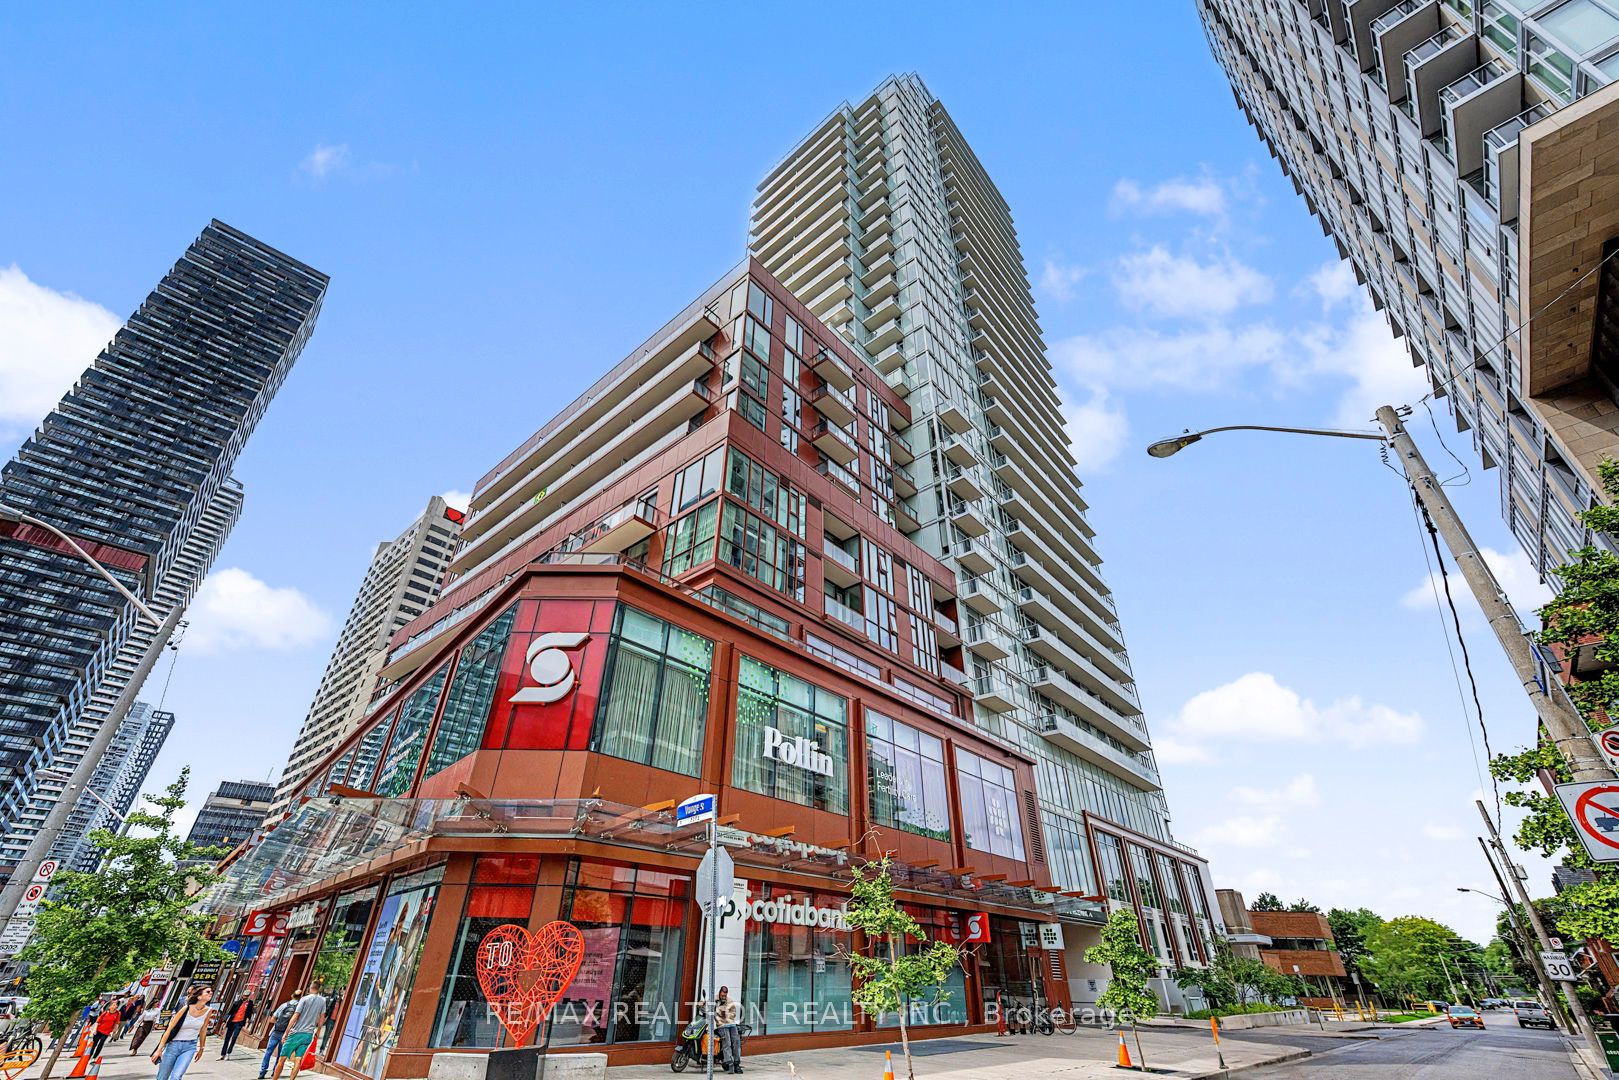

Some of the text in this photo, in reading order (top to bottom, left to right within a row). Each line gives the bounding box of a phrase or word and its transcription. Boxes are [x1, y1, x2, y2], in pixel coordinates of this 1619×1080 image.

[763, 725, 834, 778] Pollin
[486, 941, 512, 969] TO
[1548, 963, 1571, 977] 30
